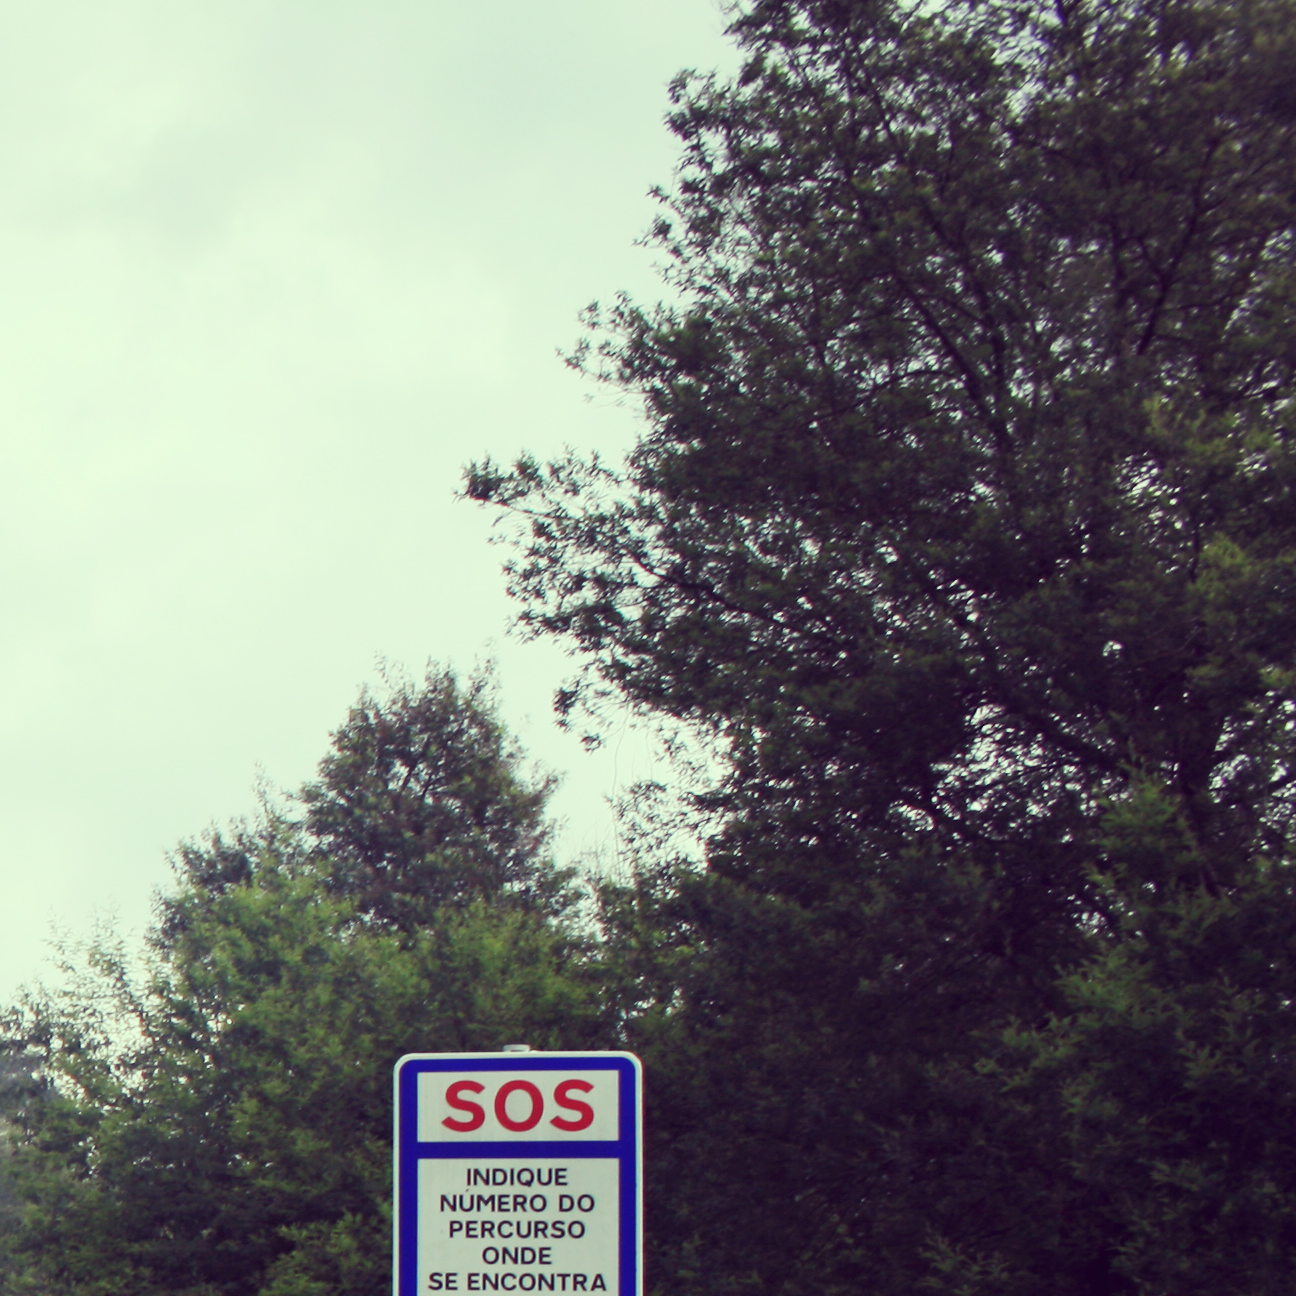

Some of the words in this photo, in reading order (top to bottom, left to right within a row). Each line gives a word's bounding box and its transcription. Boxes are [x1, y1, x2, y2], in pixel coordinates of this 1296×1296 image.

[441, 1079, 595, 1132] SOS
[466, 1168, 568, 1187] INDIQUE
[439, 1188, 547, 1213] NÚMERO
[558, 1194, 596, 1213] DO
[449, 1220, 586, 1239] PERCURSO
[482, 1246, 552, 1265] ONDE
[428, 1272, 459, 1291] SE
[466, 1273, 607, 1292] ENCONTRA
